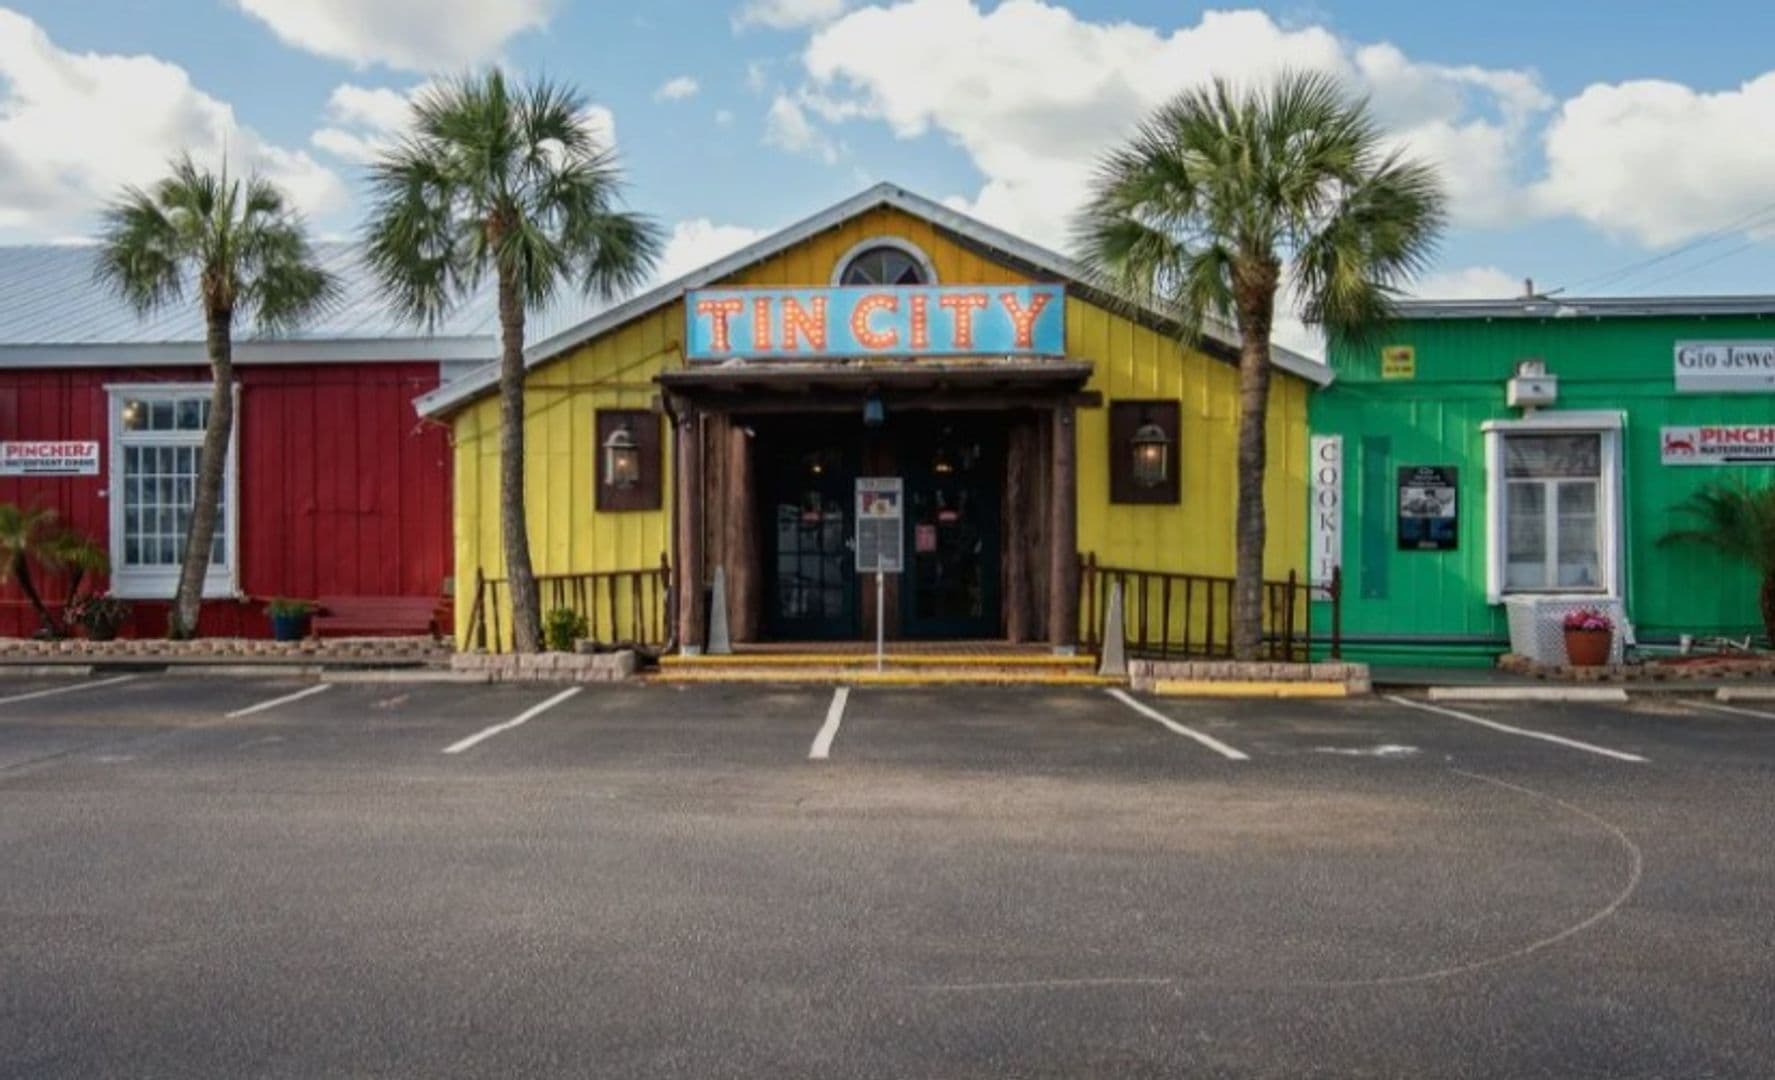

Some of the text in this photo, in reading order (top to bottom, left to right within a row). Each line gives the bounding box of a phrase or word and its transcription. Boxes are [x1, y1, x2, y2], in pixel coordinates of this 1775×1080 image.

[697, 294, 1053, 350] TIN CITY
[1678, 346, 1717, 369] Gio
[1700, 428, 1775, 443] PINCH
[6, 445, 95, 457] PINCHERS
